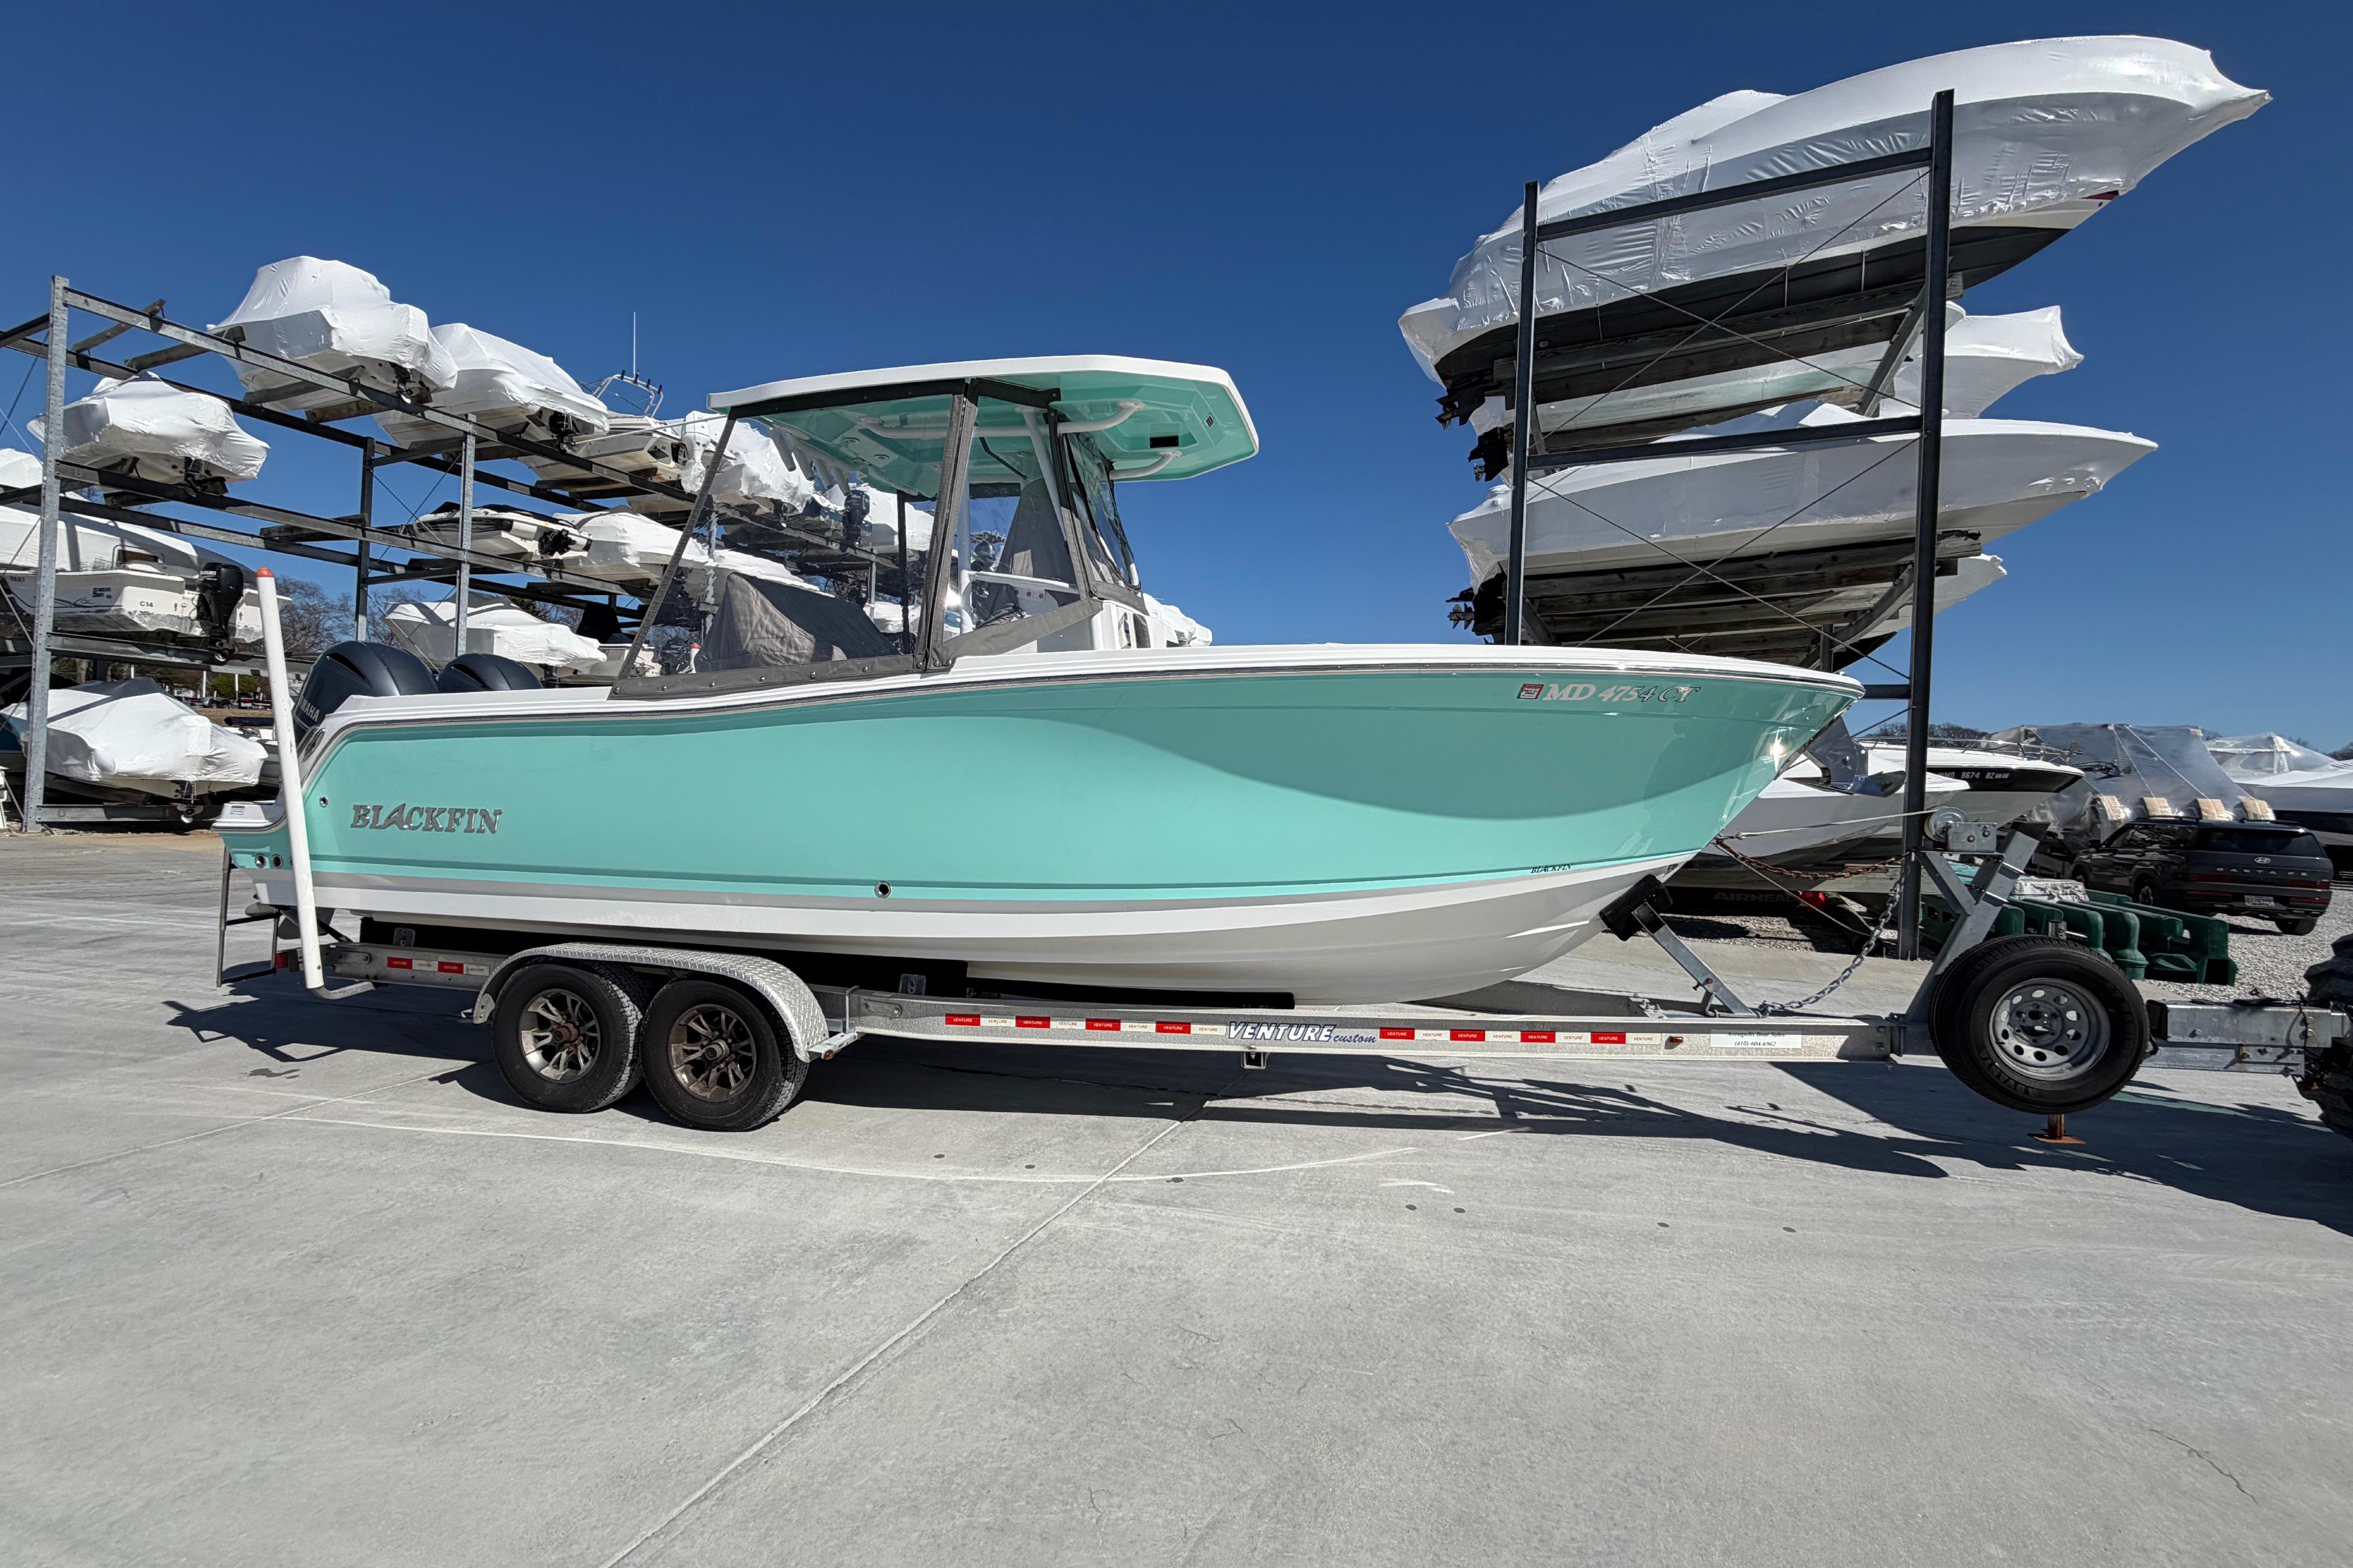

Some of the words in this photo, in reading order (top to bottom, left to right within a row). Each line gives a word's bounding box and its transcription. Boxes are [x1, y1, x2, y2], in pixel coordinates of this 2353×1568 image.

[1542, 684, 1596, 701] MD
[1598, 686, 1658, 702] 4754
[1658, 685, 1702, 702] CT
[350, 803, 504, 835] BLACKFIN
[1531, 864, 1571, 874] BLACKFIN
[1228, 1021, 1337, 1042] VENTURE
[1333, 1034, 1377, 1043] custom
